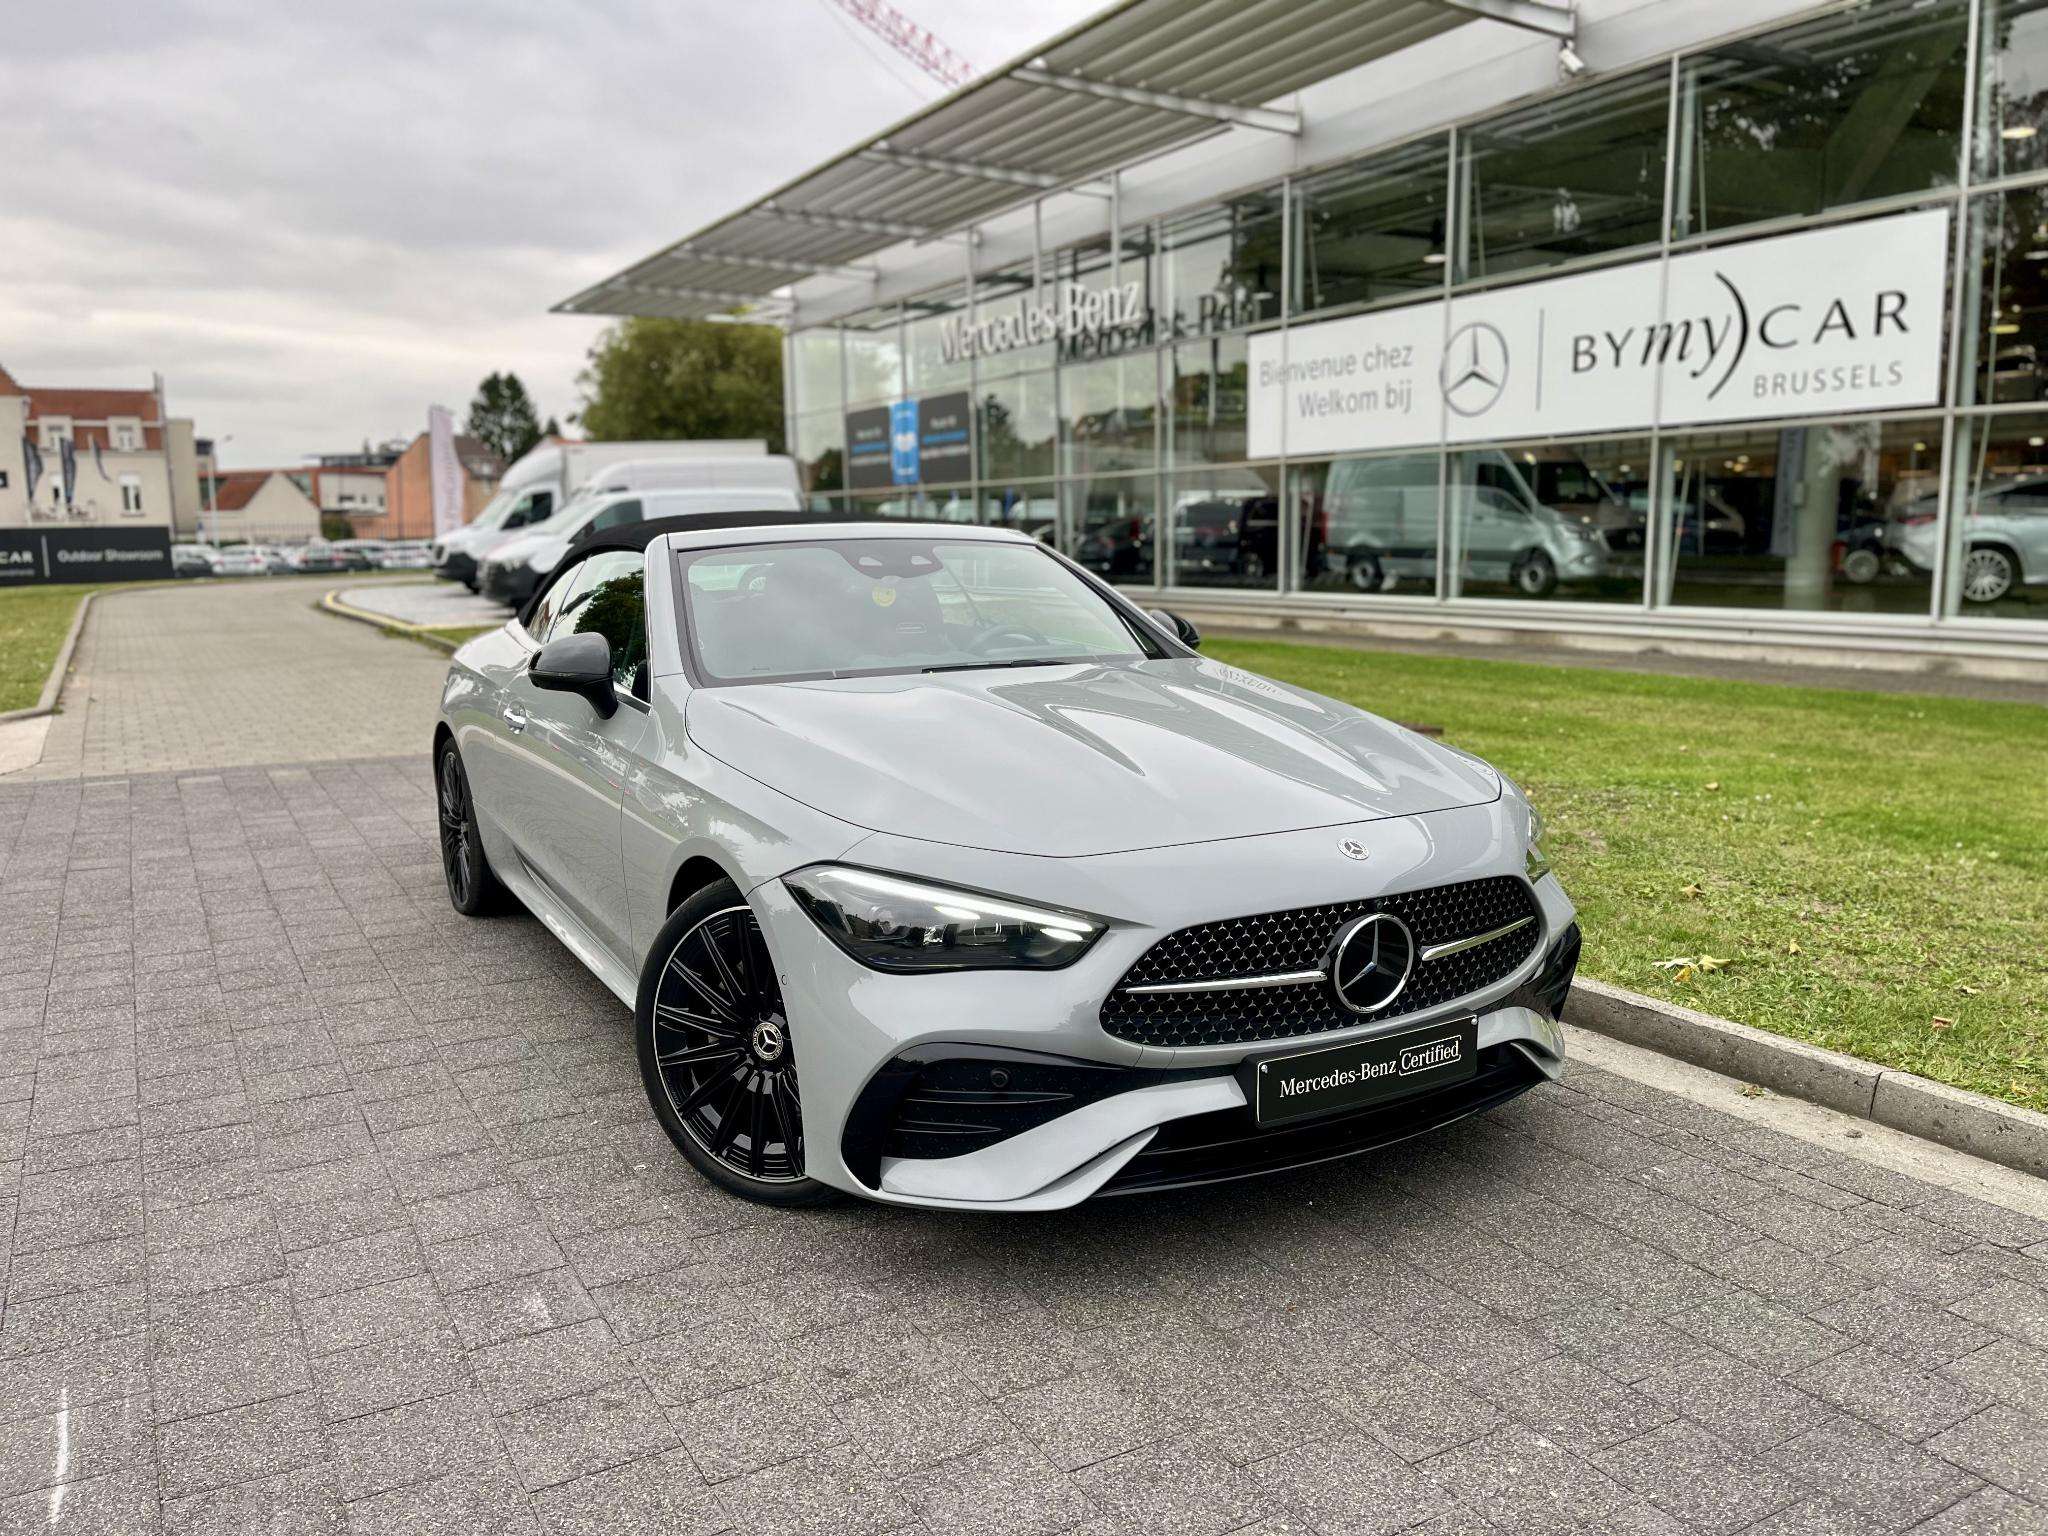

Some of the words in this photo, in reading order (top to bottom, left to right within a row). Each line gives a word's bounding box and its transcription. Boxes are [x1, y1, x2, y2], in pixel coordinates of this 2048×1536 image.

[940, 280, 1143, 363] Mercedes-Benz
[1259, 354, 1357, 387] Bienvenue
[1363, 343, 1413, 373] chez
[1753, 360, 1905, 399] BRUSSELS
[1299, 389, 1378, 418] Welkom
[1385, 379, 1413, 414] bij
[105, 548, 163, 562] Showroom
[1279, 1060, 1397, 1098] Mercedes-Benz
[1401, 1040, 1460, 1070] Certified
